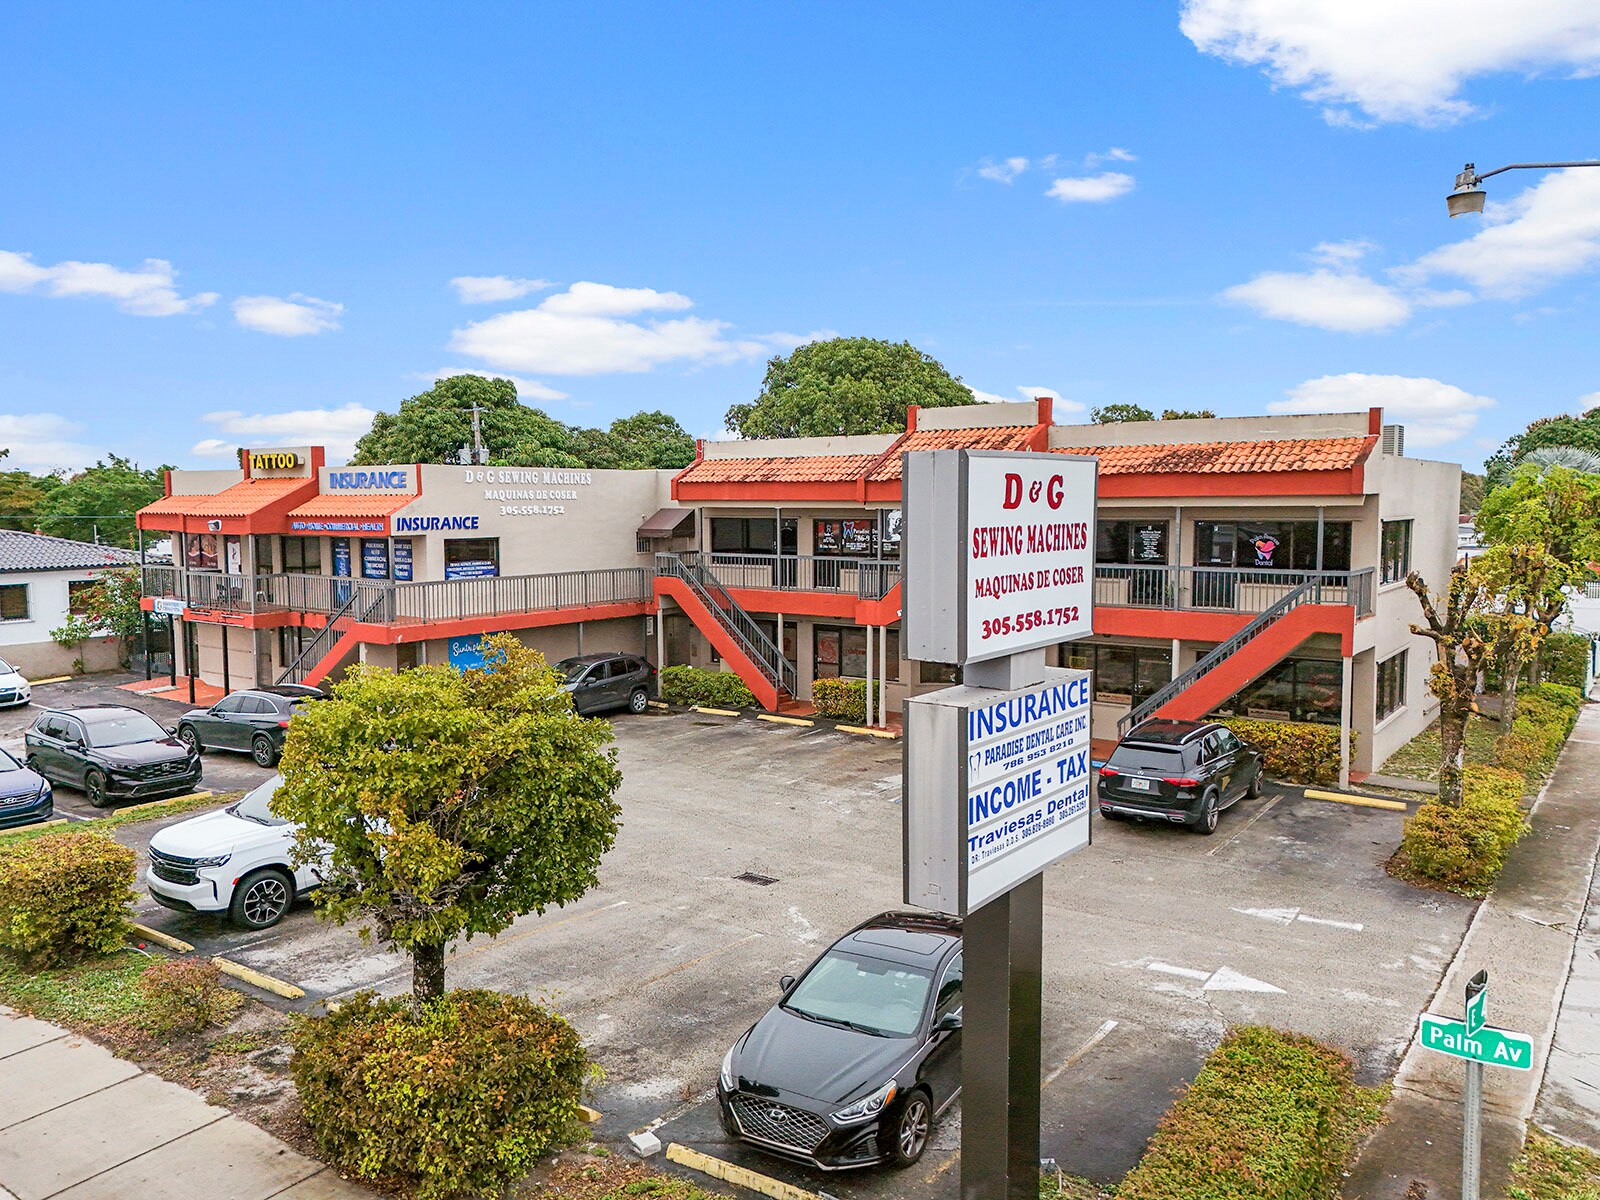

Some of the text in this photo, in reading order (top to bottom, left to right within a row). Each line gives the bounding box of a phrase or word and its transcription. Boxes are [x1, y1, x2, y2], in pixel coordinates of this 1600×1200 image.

[248, 451, 296, 470] TATTOO
[465, 470, 592, 486] D & G SEWING MACHINES
[329, 471, 407, 489] INSURANCE
[484, 489, 578, 502] MAQUINAS DE COSER
[1002, 473, 1065, 510] D & G
[396, 516, 479, 532] INSURANCE
[499, 505, 566, 516] 305.558.1752
[972, 522, 1088, 560] SEWING MACHINES
[975, 565, 1085, 600] MAQUINAS DE COSER
[981, 605, 1079, 640] 305.558.1752
[969, 677, 1089, 741] INSURANCE
[984, 736, 1024, 767] PARADISE
[1025, 726, 1055, 752] DENTAL
[1055, 719, 1074, 741] CARE
[1003, 737, 1074, 771] 786 953 8210
[968, 769, 1042, 825] INCOME
[1056, 750, 1087, 785] TAX
[968, 784, 1089, 853] Traviesas Dental
[981, 842, 1005, 860] Traviesas
[1430, 1026, 1523, 1062] Palm Av
